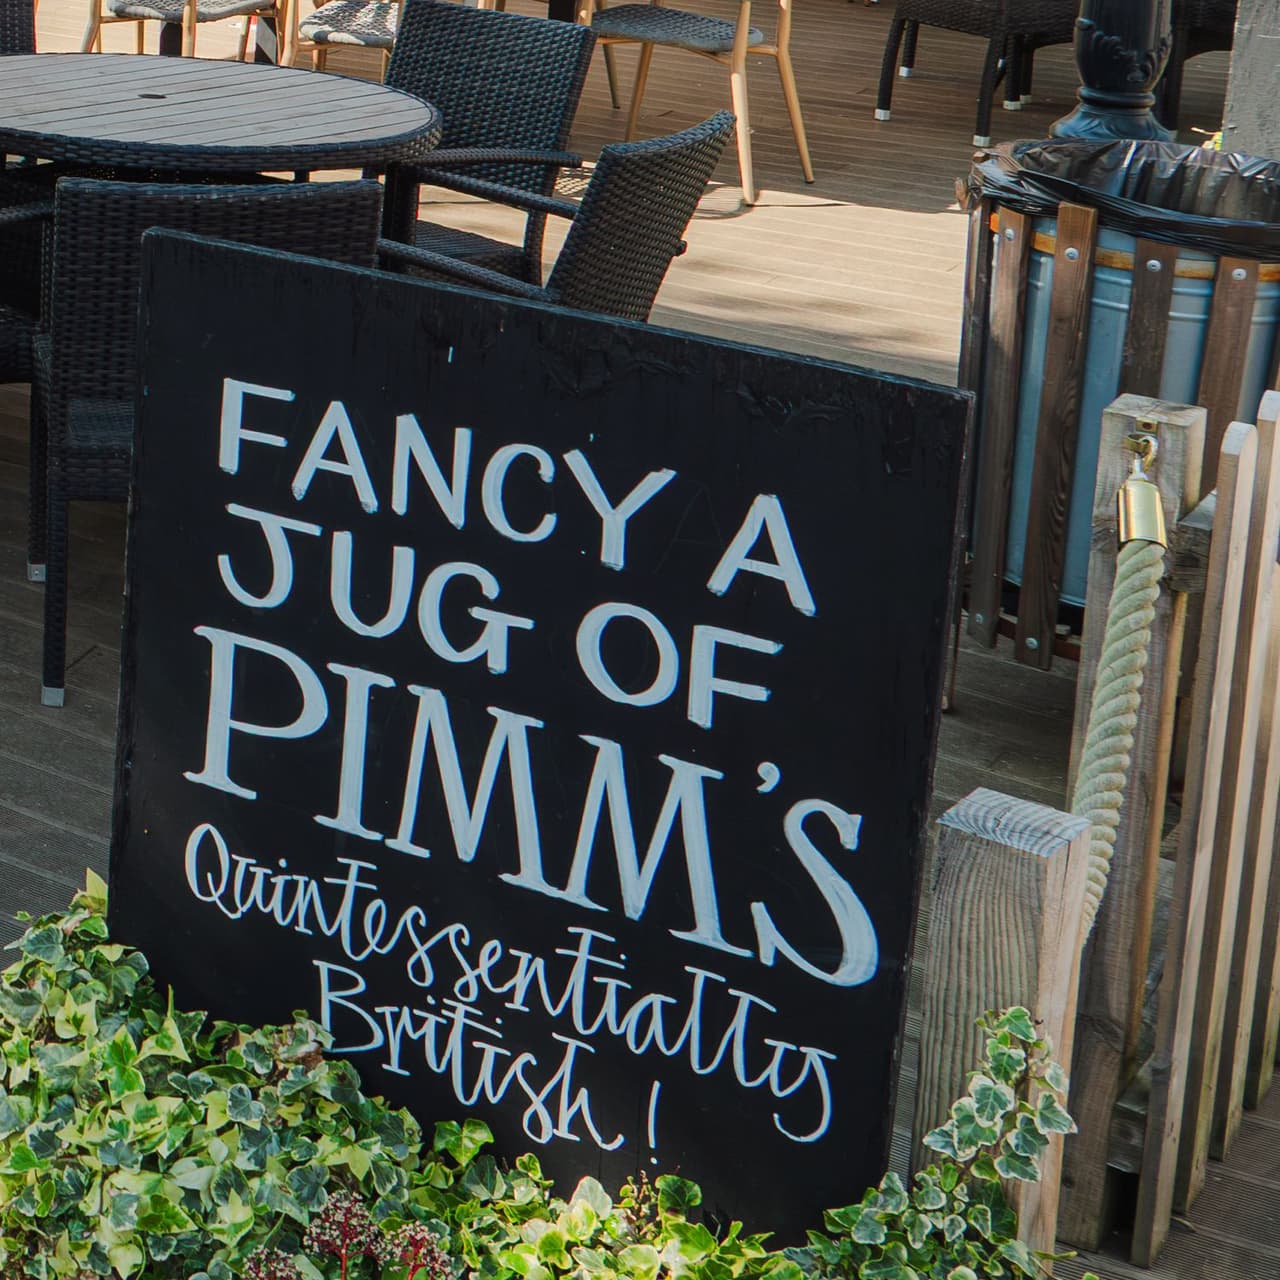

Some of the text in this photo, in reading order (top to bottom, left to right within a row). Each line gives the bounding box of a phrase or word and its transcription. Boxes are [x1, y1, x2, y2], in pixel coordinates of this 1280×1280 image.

[216, 502, 785, 729] JUG OF
[217, 376, 817, 617] FANCY A
[182, 624, 880, 988] PIMM'S
[183, 822, 838, 1143] Quintessentially
